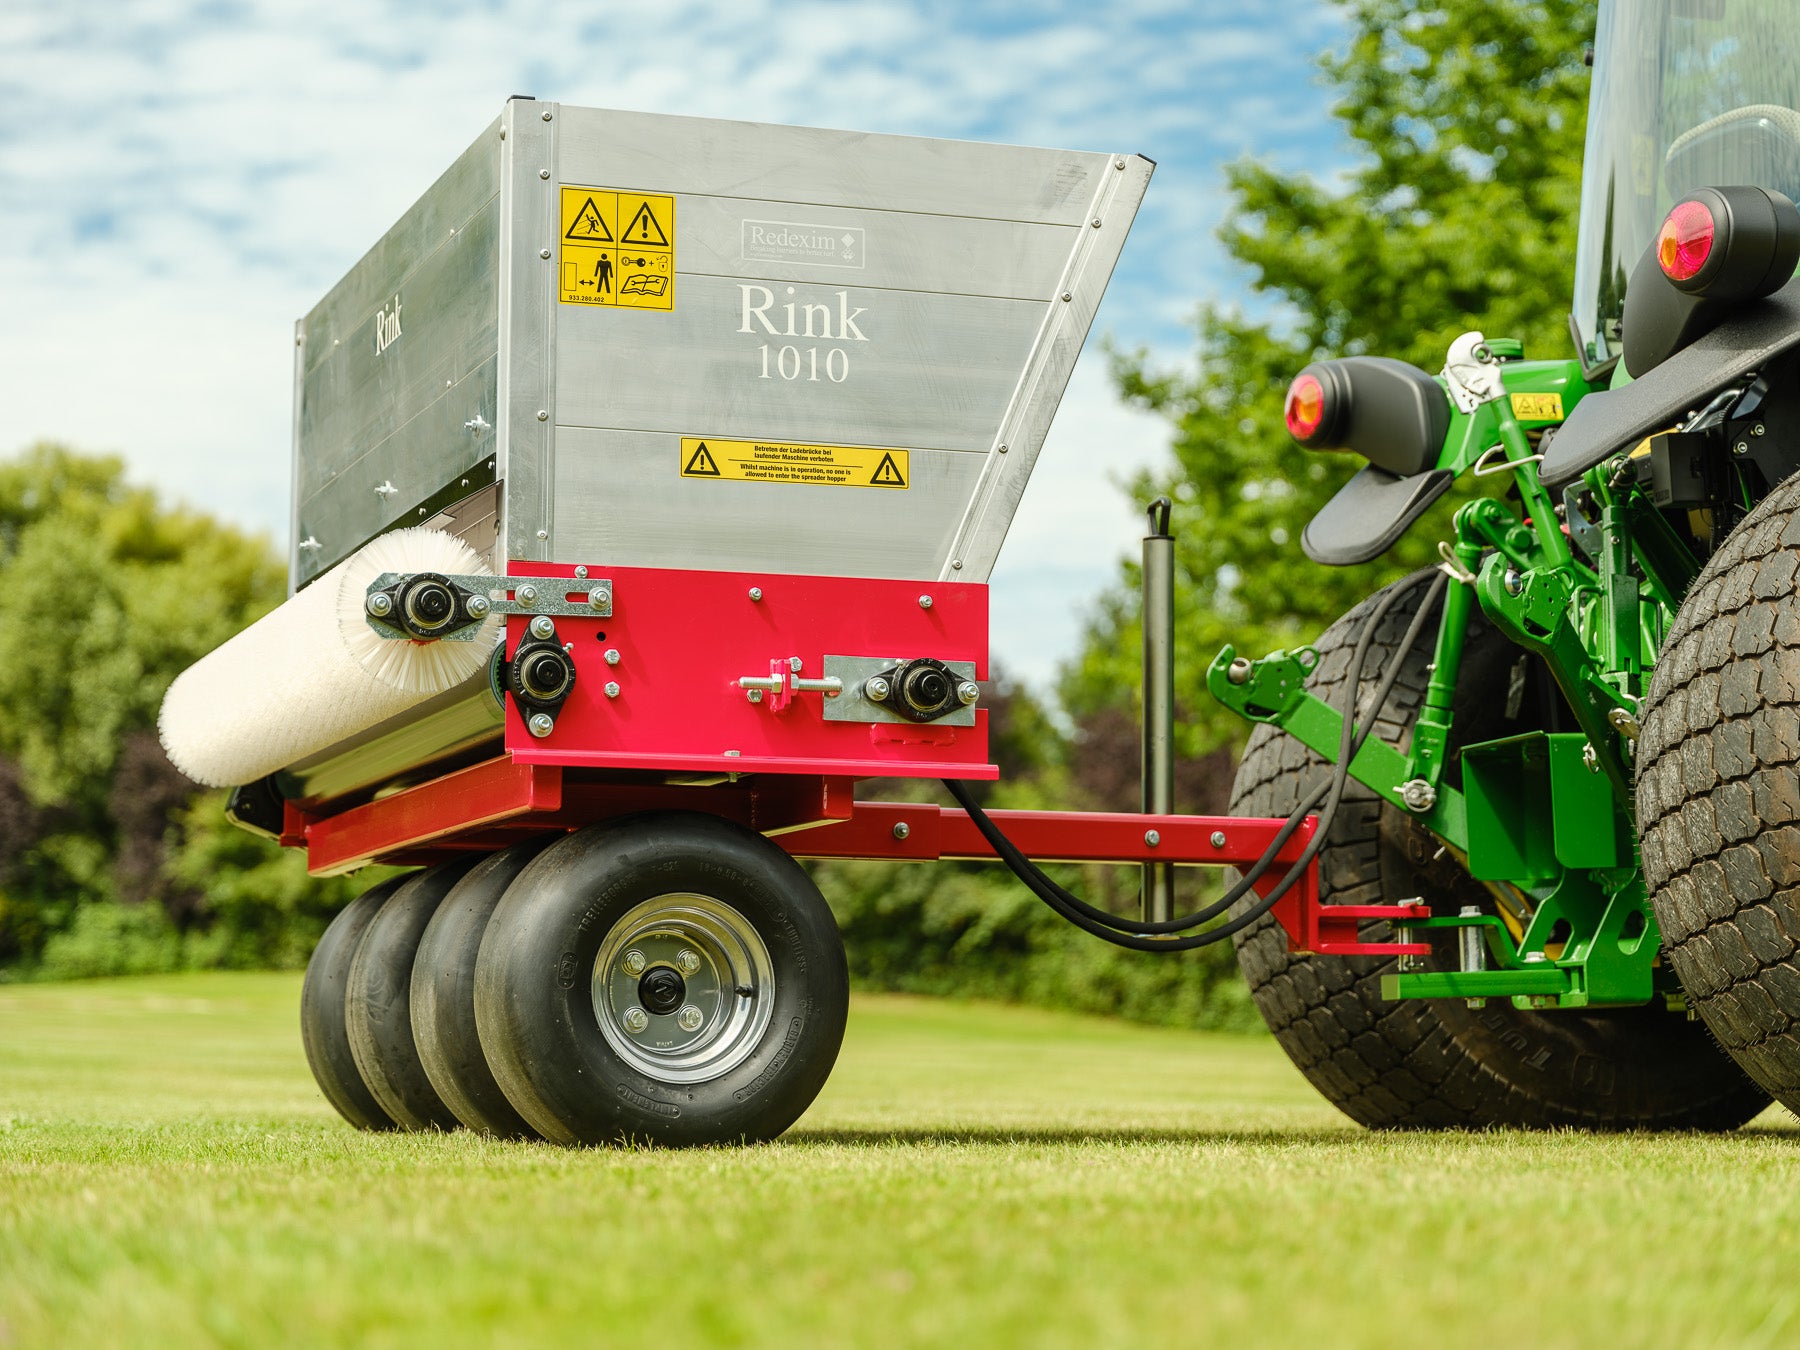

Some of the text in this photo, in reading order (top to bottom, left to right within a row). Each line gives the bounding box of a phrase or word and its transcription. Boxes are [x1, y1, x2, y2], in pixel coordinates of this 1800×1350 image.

[750, 225, 835, 250] Redexim
[568, 295, 605, 303] 933.280.402
[736, 284, 870, 342] Rink
[375, 293, 403, 357] Rink
[757, 345, 849, 383] 1010
[754, 445, 779, 453] Betreten
